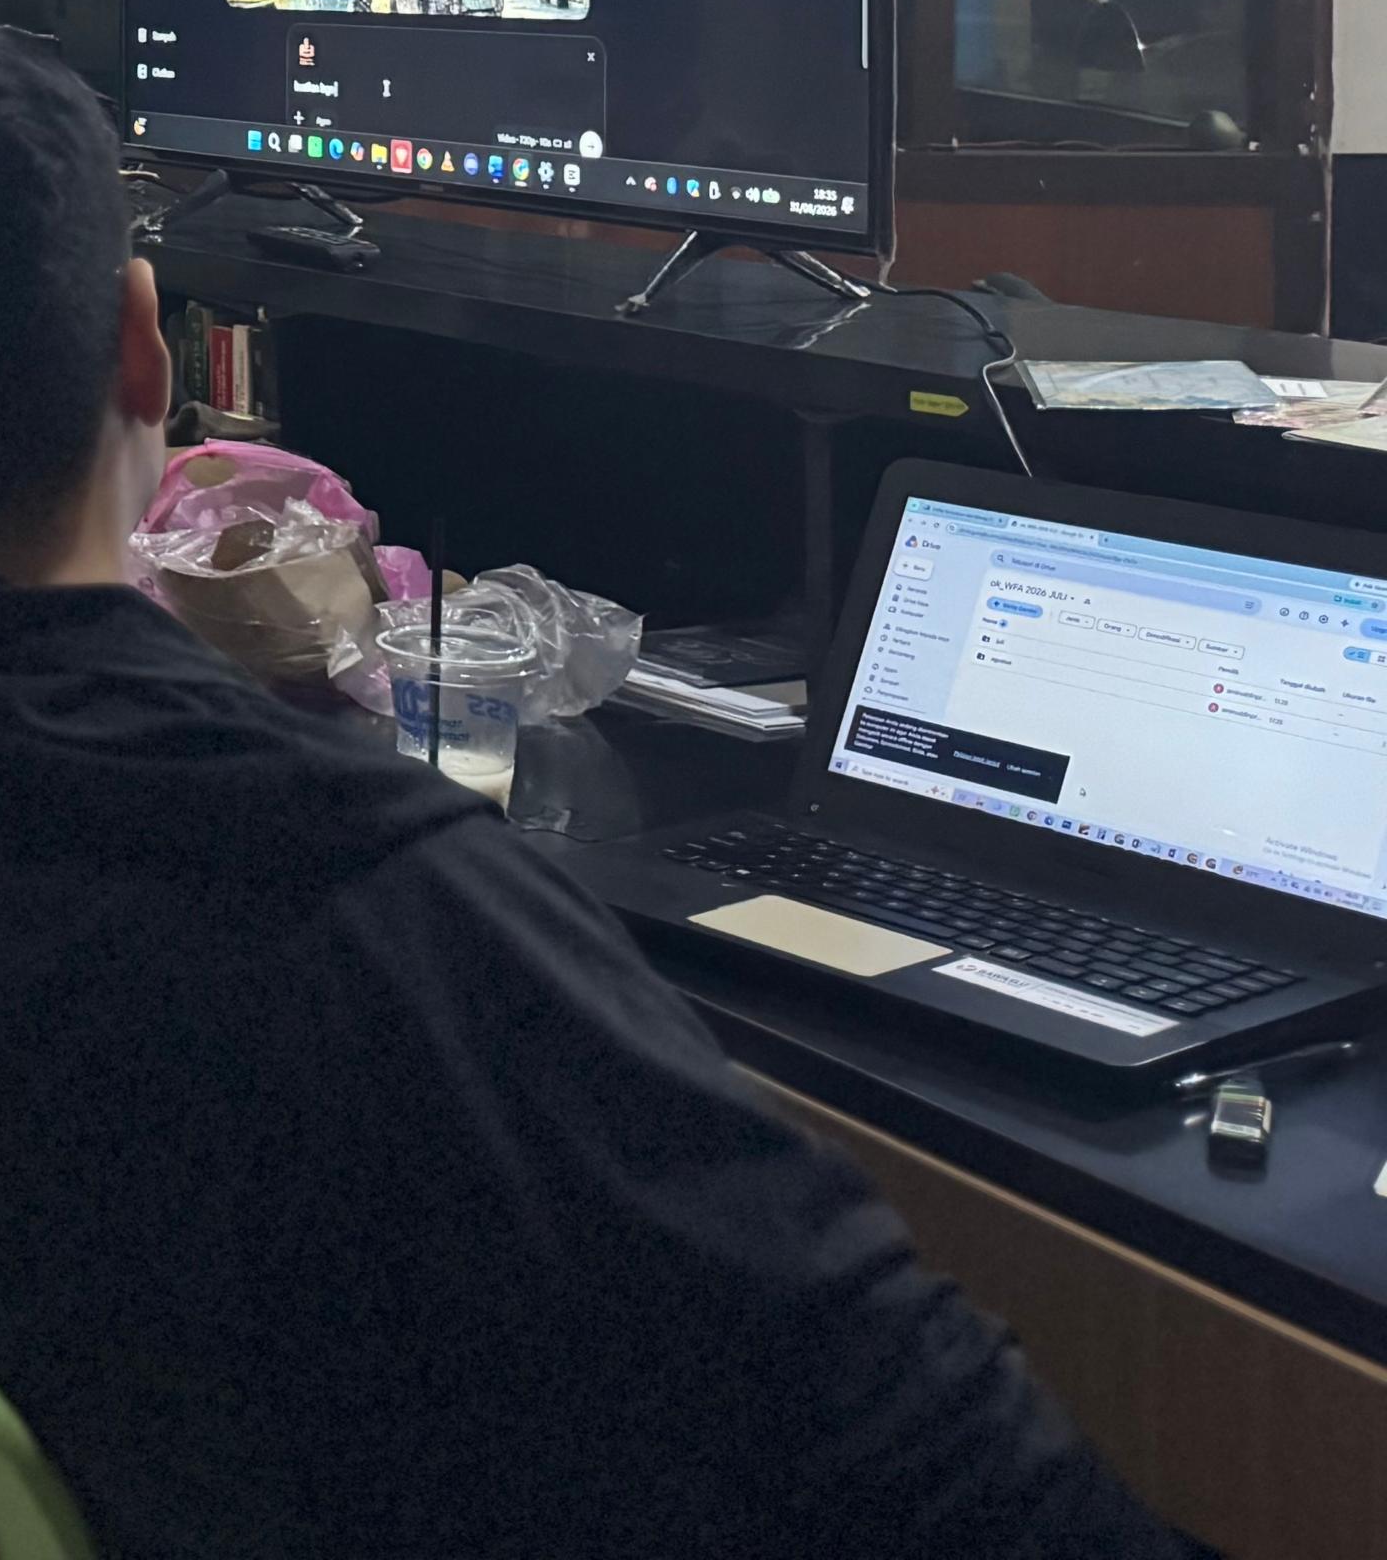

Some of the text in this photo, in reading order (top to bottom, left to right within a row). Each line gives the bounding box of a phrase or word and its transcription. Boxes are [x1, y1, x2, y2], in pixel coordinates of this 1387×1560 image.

[922, 540, 941, 550] Drive
[1025, 585, 1047, 597] 2026
[1048, 589, 1068, 601] JULI
[1265, 836, 1339, 861] Activate Windows
